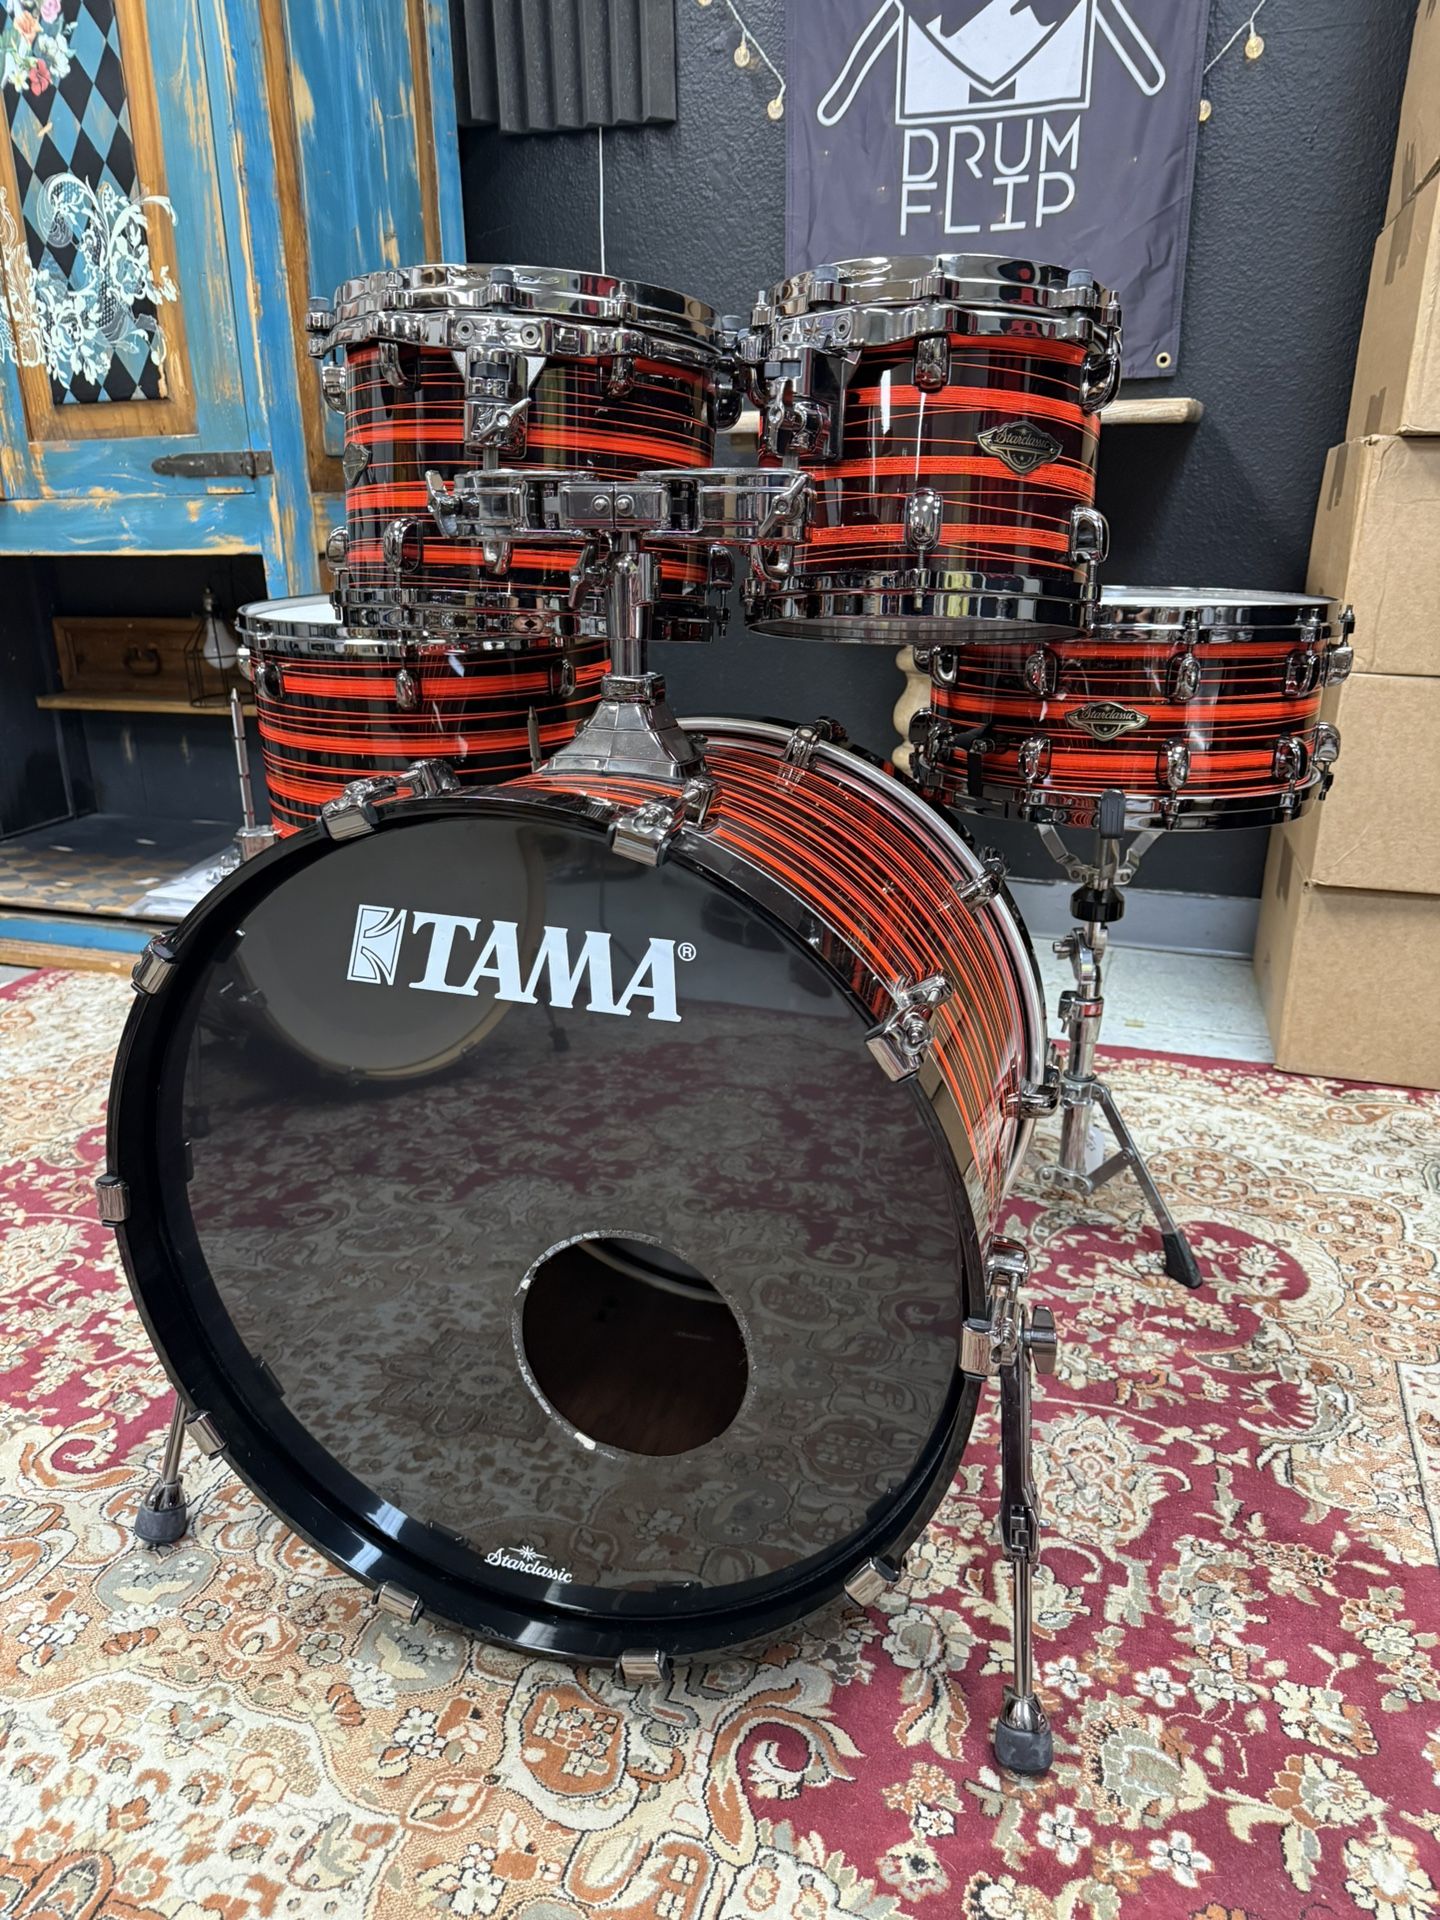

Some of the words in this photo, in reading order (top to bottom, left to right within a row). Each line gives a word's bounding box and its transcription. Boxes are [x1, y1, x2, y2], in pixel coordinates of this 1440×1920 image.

[902, 114, 1081, 182] DRUM
[900, 171, 1076, 237] FLIP
[994, 427, 1050, 449] Starclassic
[1080, 705, 1135, 720] Starclassic
[484, 1547, 573, 1584] Starclassic
